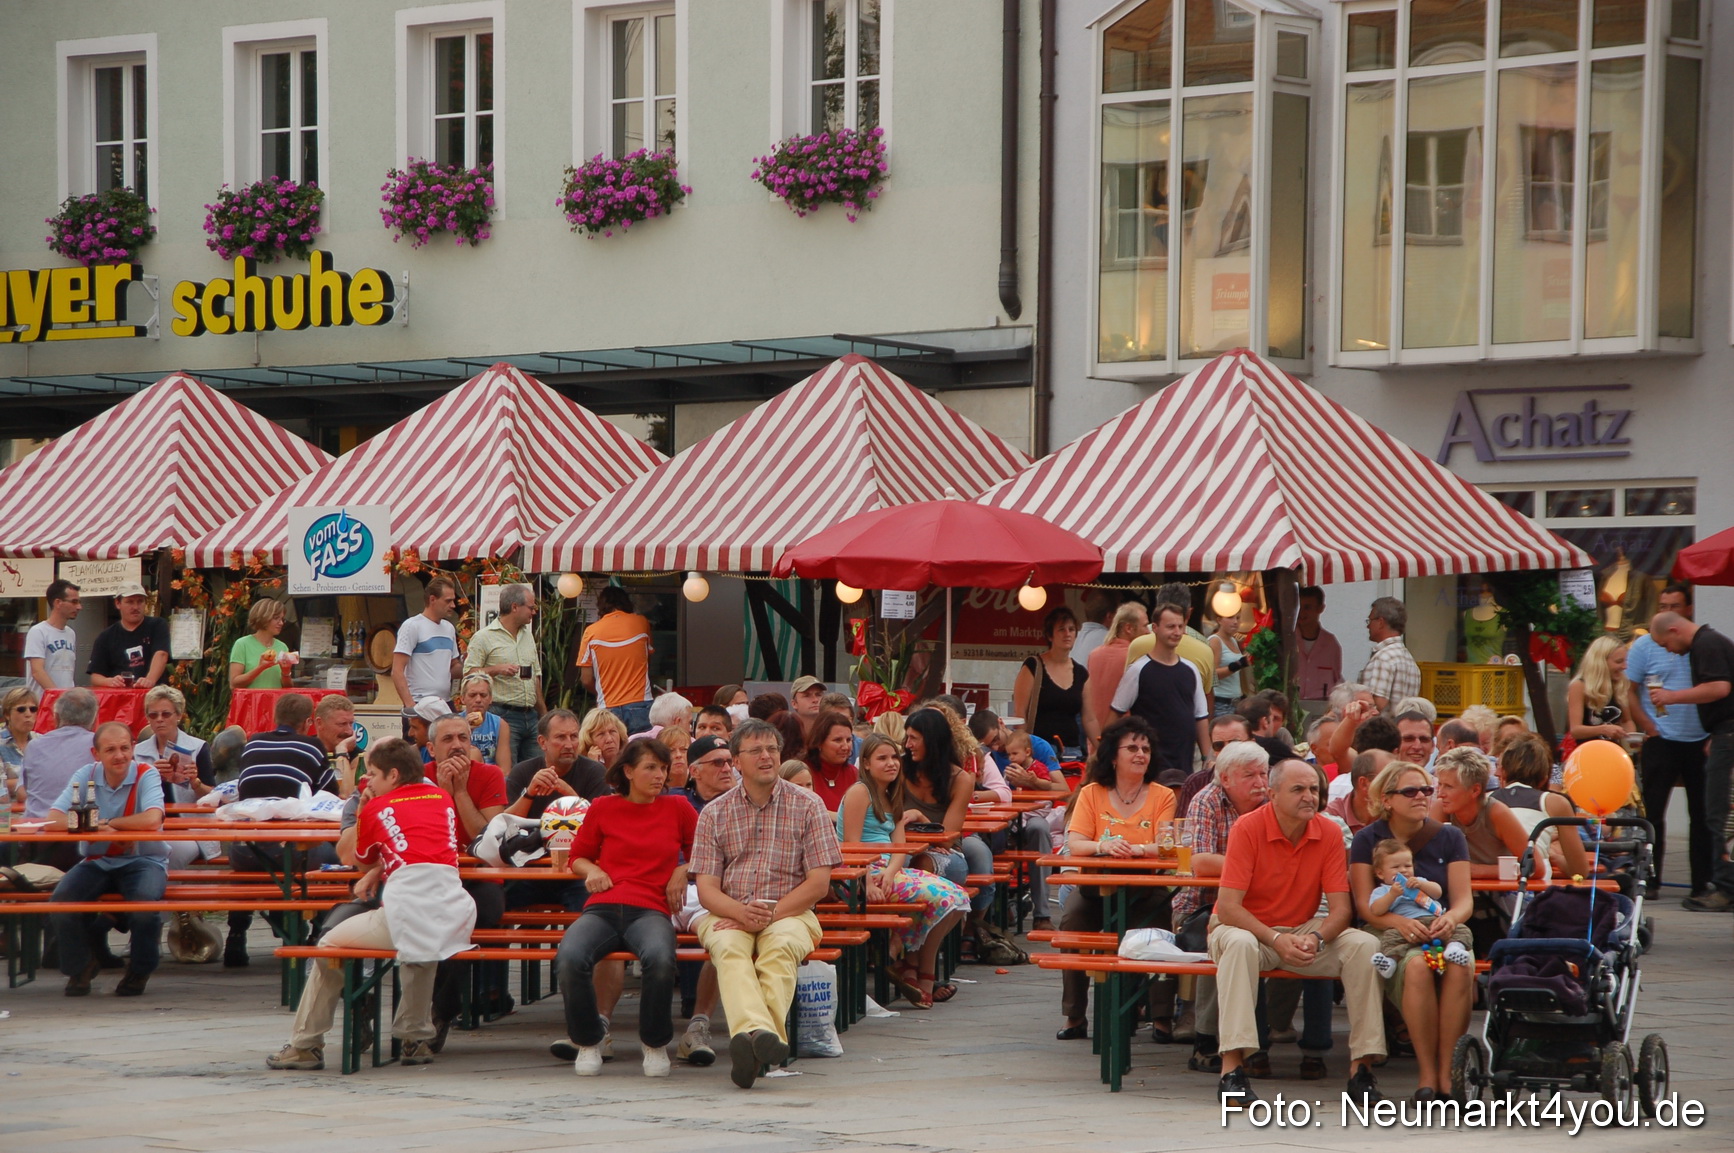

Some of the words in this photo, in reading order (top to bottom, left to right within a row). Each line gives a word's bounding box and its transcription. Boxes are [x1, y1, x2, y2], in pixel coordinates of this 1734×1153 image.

[0, 263, 134, 343] yer
[171, 250, 392, 338] schuhe
[1436, 391, 1632, 465] Achatz
[309, 521, 336, 550] vom
[310, 522, 364, 581] FASS
[293, 583, 311, 592] Sehen
[316, 582, 347, 592] Probieren
[352, 582, 385, 591] Geniessen
[985, 648, 1017, 658] Neumarkt
[993, 628, 1007, 636] am
[377, 806, 409, 852] Saeco
